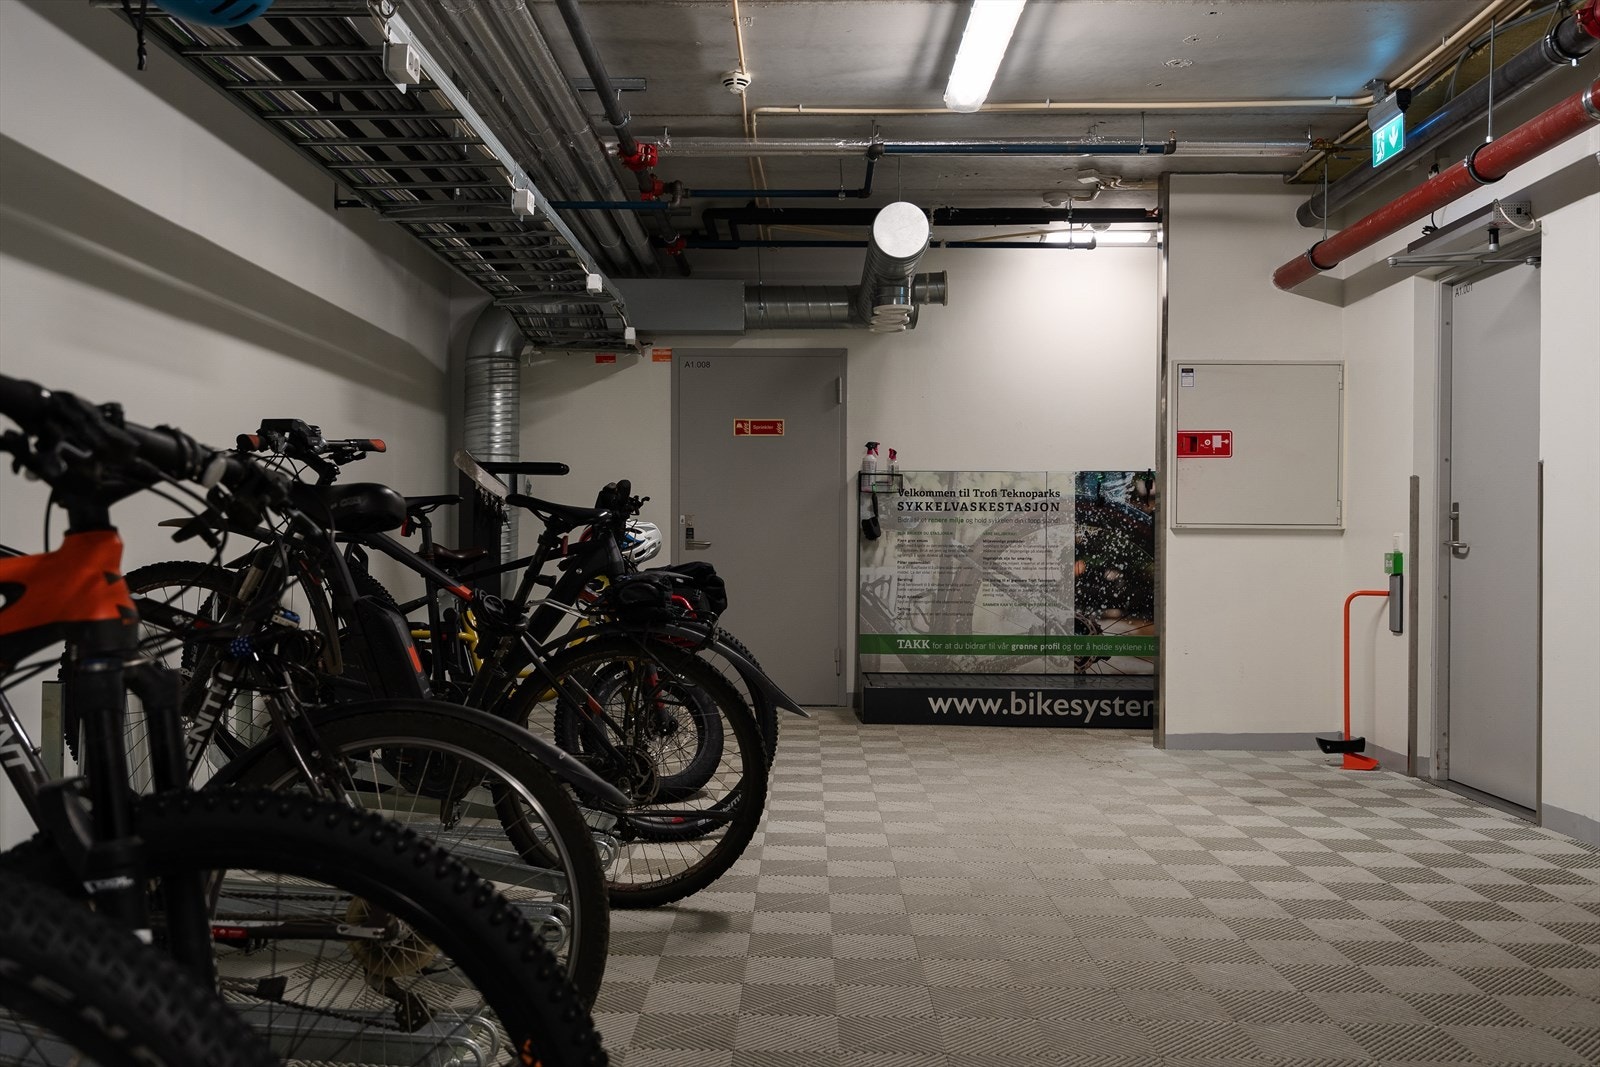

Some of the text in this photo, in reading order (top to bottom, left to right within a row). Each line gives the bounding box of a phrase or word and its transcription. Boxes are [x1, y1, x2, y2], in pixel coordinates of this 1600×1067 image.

[684, 361, 711, 369] A1.008
[897, 488, 1061, 500] Velkommen til Trofi Teknoparks
[897, 501, 1061, 512] SYKKELVASKESTASJON
[965, 518, 973, 526] og
[896, 639, 930, 649] TAKK
[953, 642, 964, 650] du
[965, 642, 987, 650] bidrar
[988, 642, 996, 650] til
[997, 642, 1009, 650] vår
[1010, 643, 1038, 653] grønne
[1039, 642, 1060, 653] profil
[1062, 644, 1072, 653] og
[1073, 642, 1084, 650] for
[1086, 642, 1091, 650] å
[1092, 643, 1113, 651] holde
[1114, 643, 1142, 652] syklene
